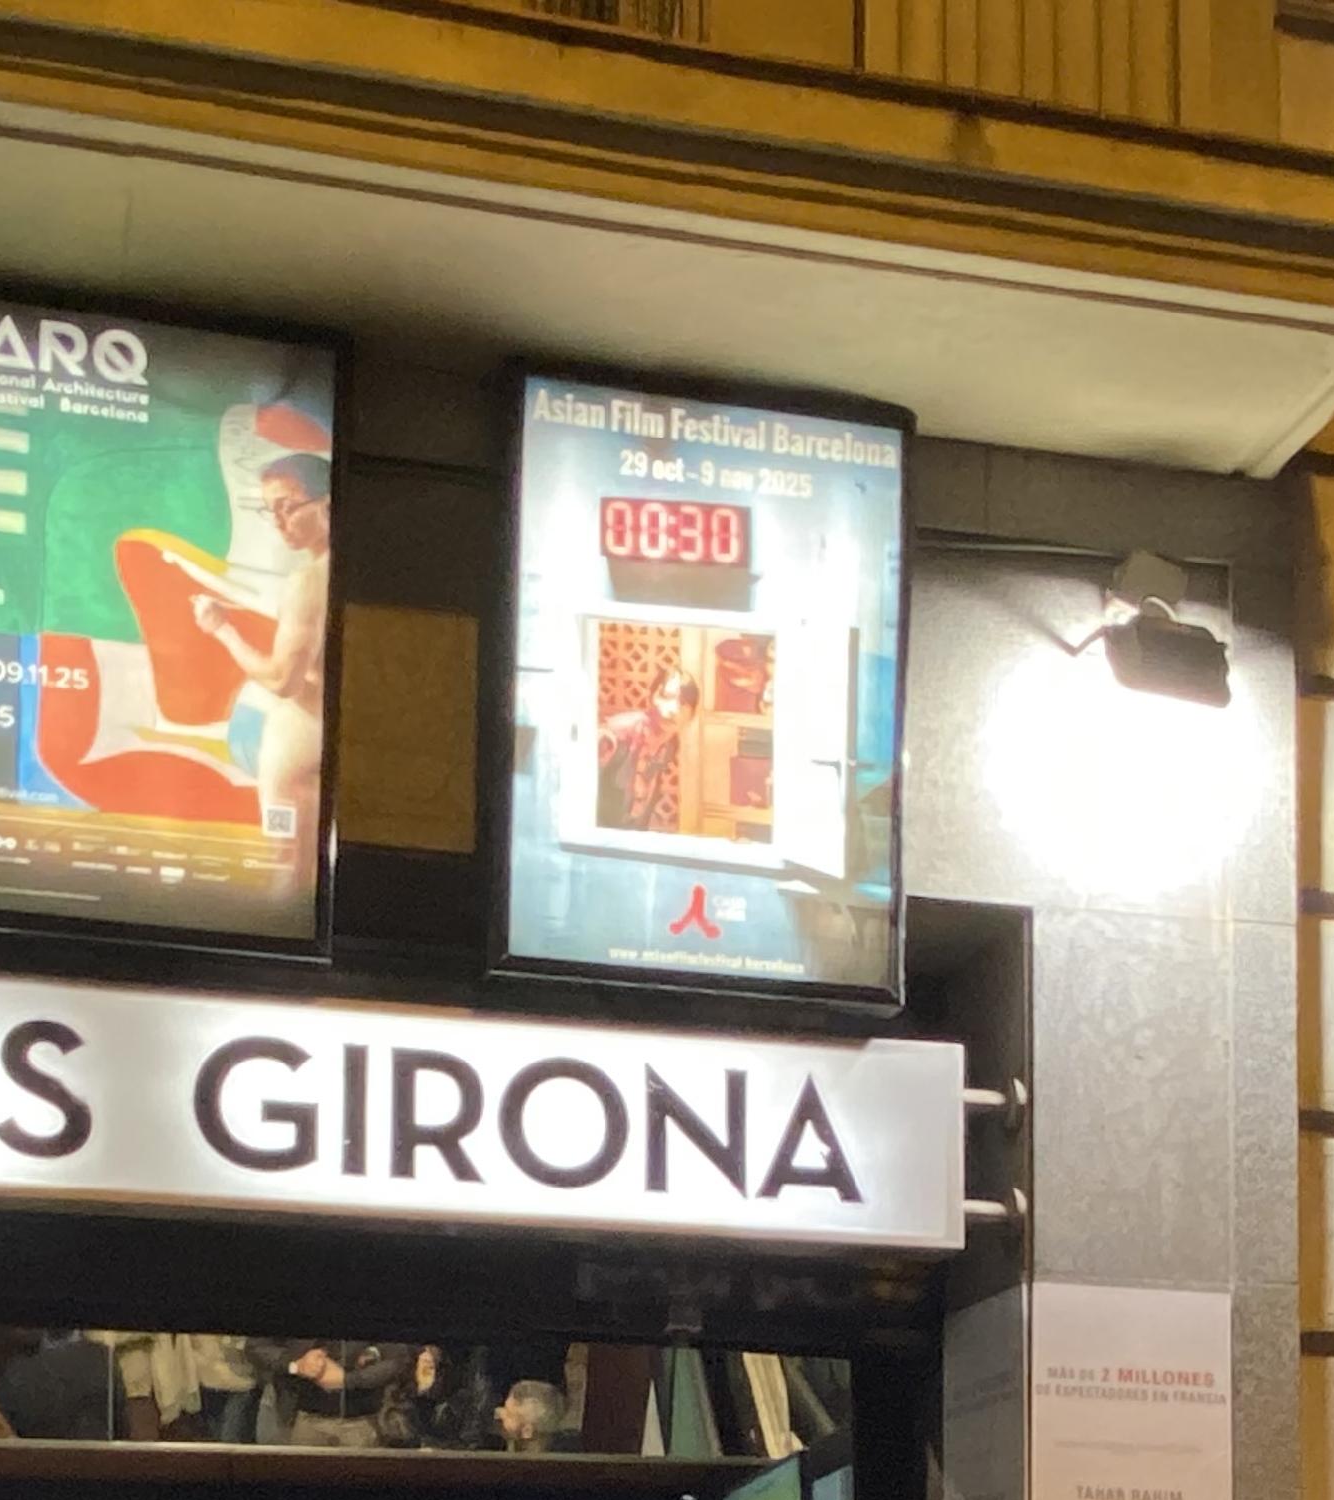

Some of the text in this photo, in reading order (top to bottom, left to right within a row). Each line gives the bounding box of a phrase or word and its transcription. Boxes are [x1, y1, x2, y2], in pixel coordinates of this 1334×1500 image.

[42, 377, 150, 405] Architecture
[60, 397, 149, 423] Barcelona
[532, 388, 897, 468] Asian Film Festival Barcelona
[619, 448, 648, 478] 29
[652, 457, 685, 483] oct
[757, 468, 814, 498] 2025
[605, 501, 741, 564] 00:30
[192, 1036, 865, 1203] GIRONA
[1101, 1368, 1110, 1383] 2
[1117, 1368, 1215, 1388] MILLONES
